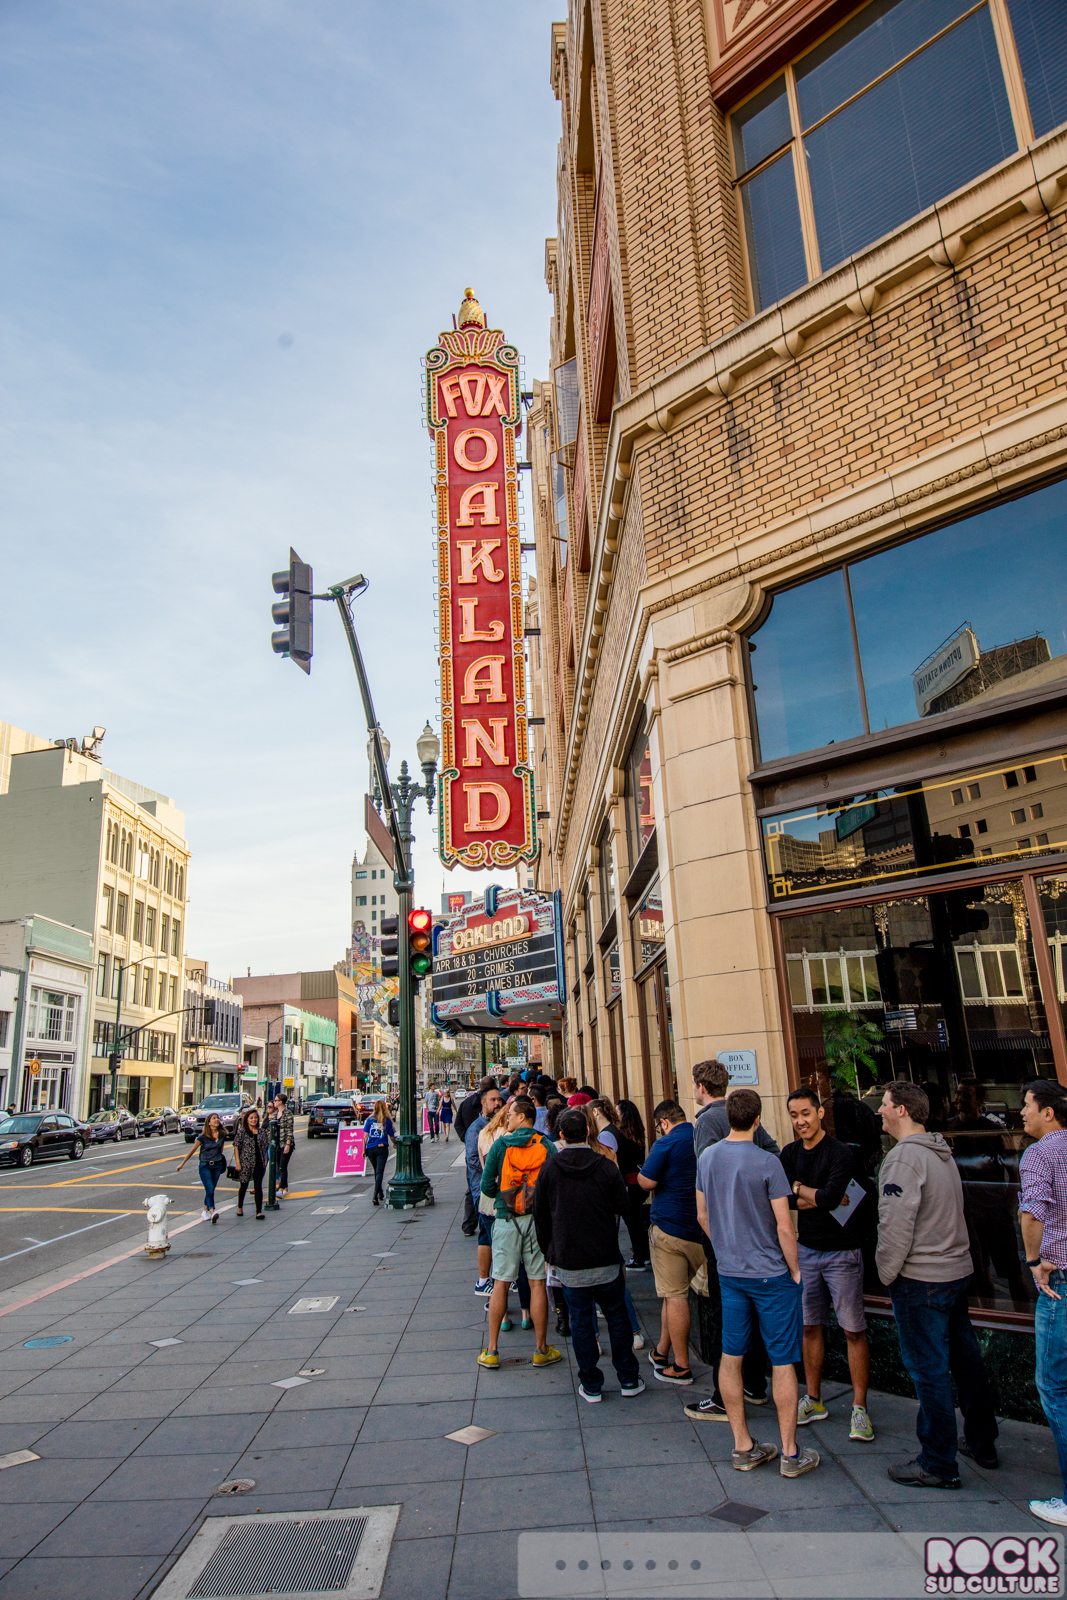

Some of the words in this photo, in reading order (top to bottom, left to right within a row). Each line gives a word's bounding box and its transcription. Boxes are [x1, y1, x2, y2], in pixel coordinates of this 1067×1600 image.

[440, 372, 507, 418] FOX
[453, 427, 511, 833] OAKLAND
[452, 915, 529, 950] OAKLAND
[436, 959, 451, 973] APR
[453, 957, 461, 969] 18
[461, 956, 467, 967] &
[468, 953, 476, 965] 19
[484, 941, 529, 961] CHVRCHES
[467, 968, 476, 980] 20
[484, 960, 515, 977] GRIMES
[468, 984, 477, 996] 22
[485, 976, 512, 992] JAMES
[515, 972, 533, 987] BAY
